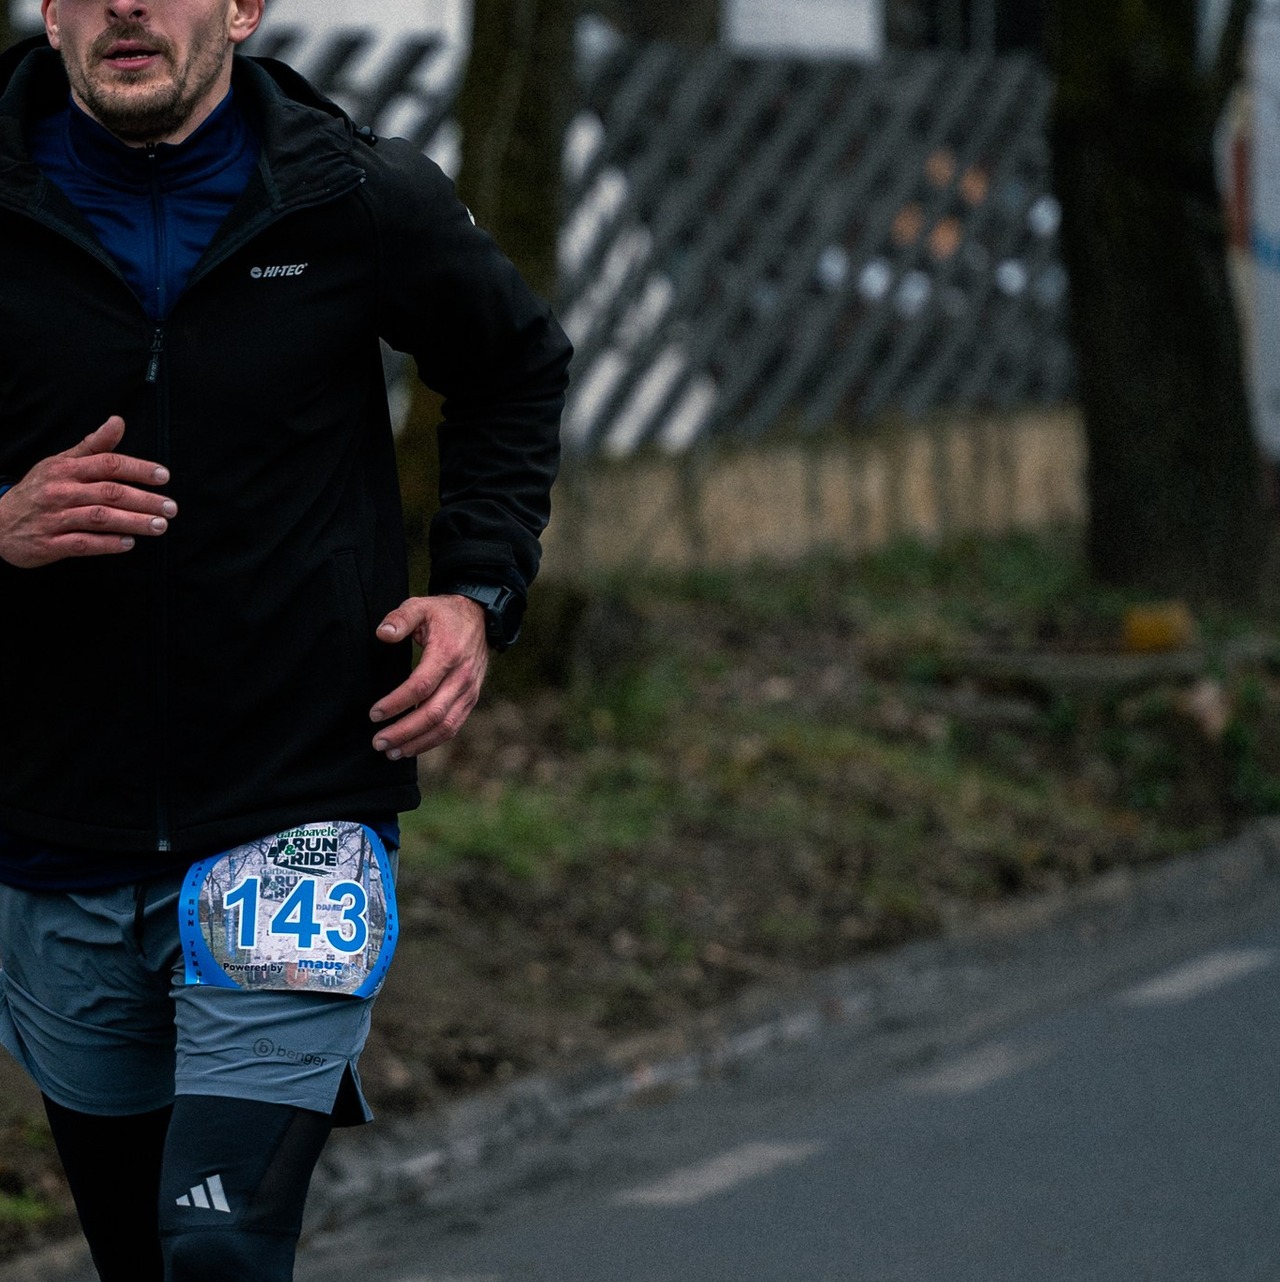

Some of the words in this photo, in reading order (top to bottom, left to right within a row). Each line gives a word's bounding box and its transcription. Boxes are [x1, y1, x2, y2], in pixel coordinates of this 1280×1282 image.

[285, 845, 296, 855] &
[293, 838, 338, 852] RUN
[291, 853, 337, 866] RIDE
[224, 877, 368, 953] 143
[223, 962, 267, 972] Powered
[270, 963, 283, 973] by
[298, 960, 343, 970] maus
[276, 1045, 327, 1067] benger
